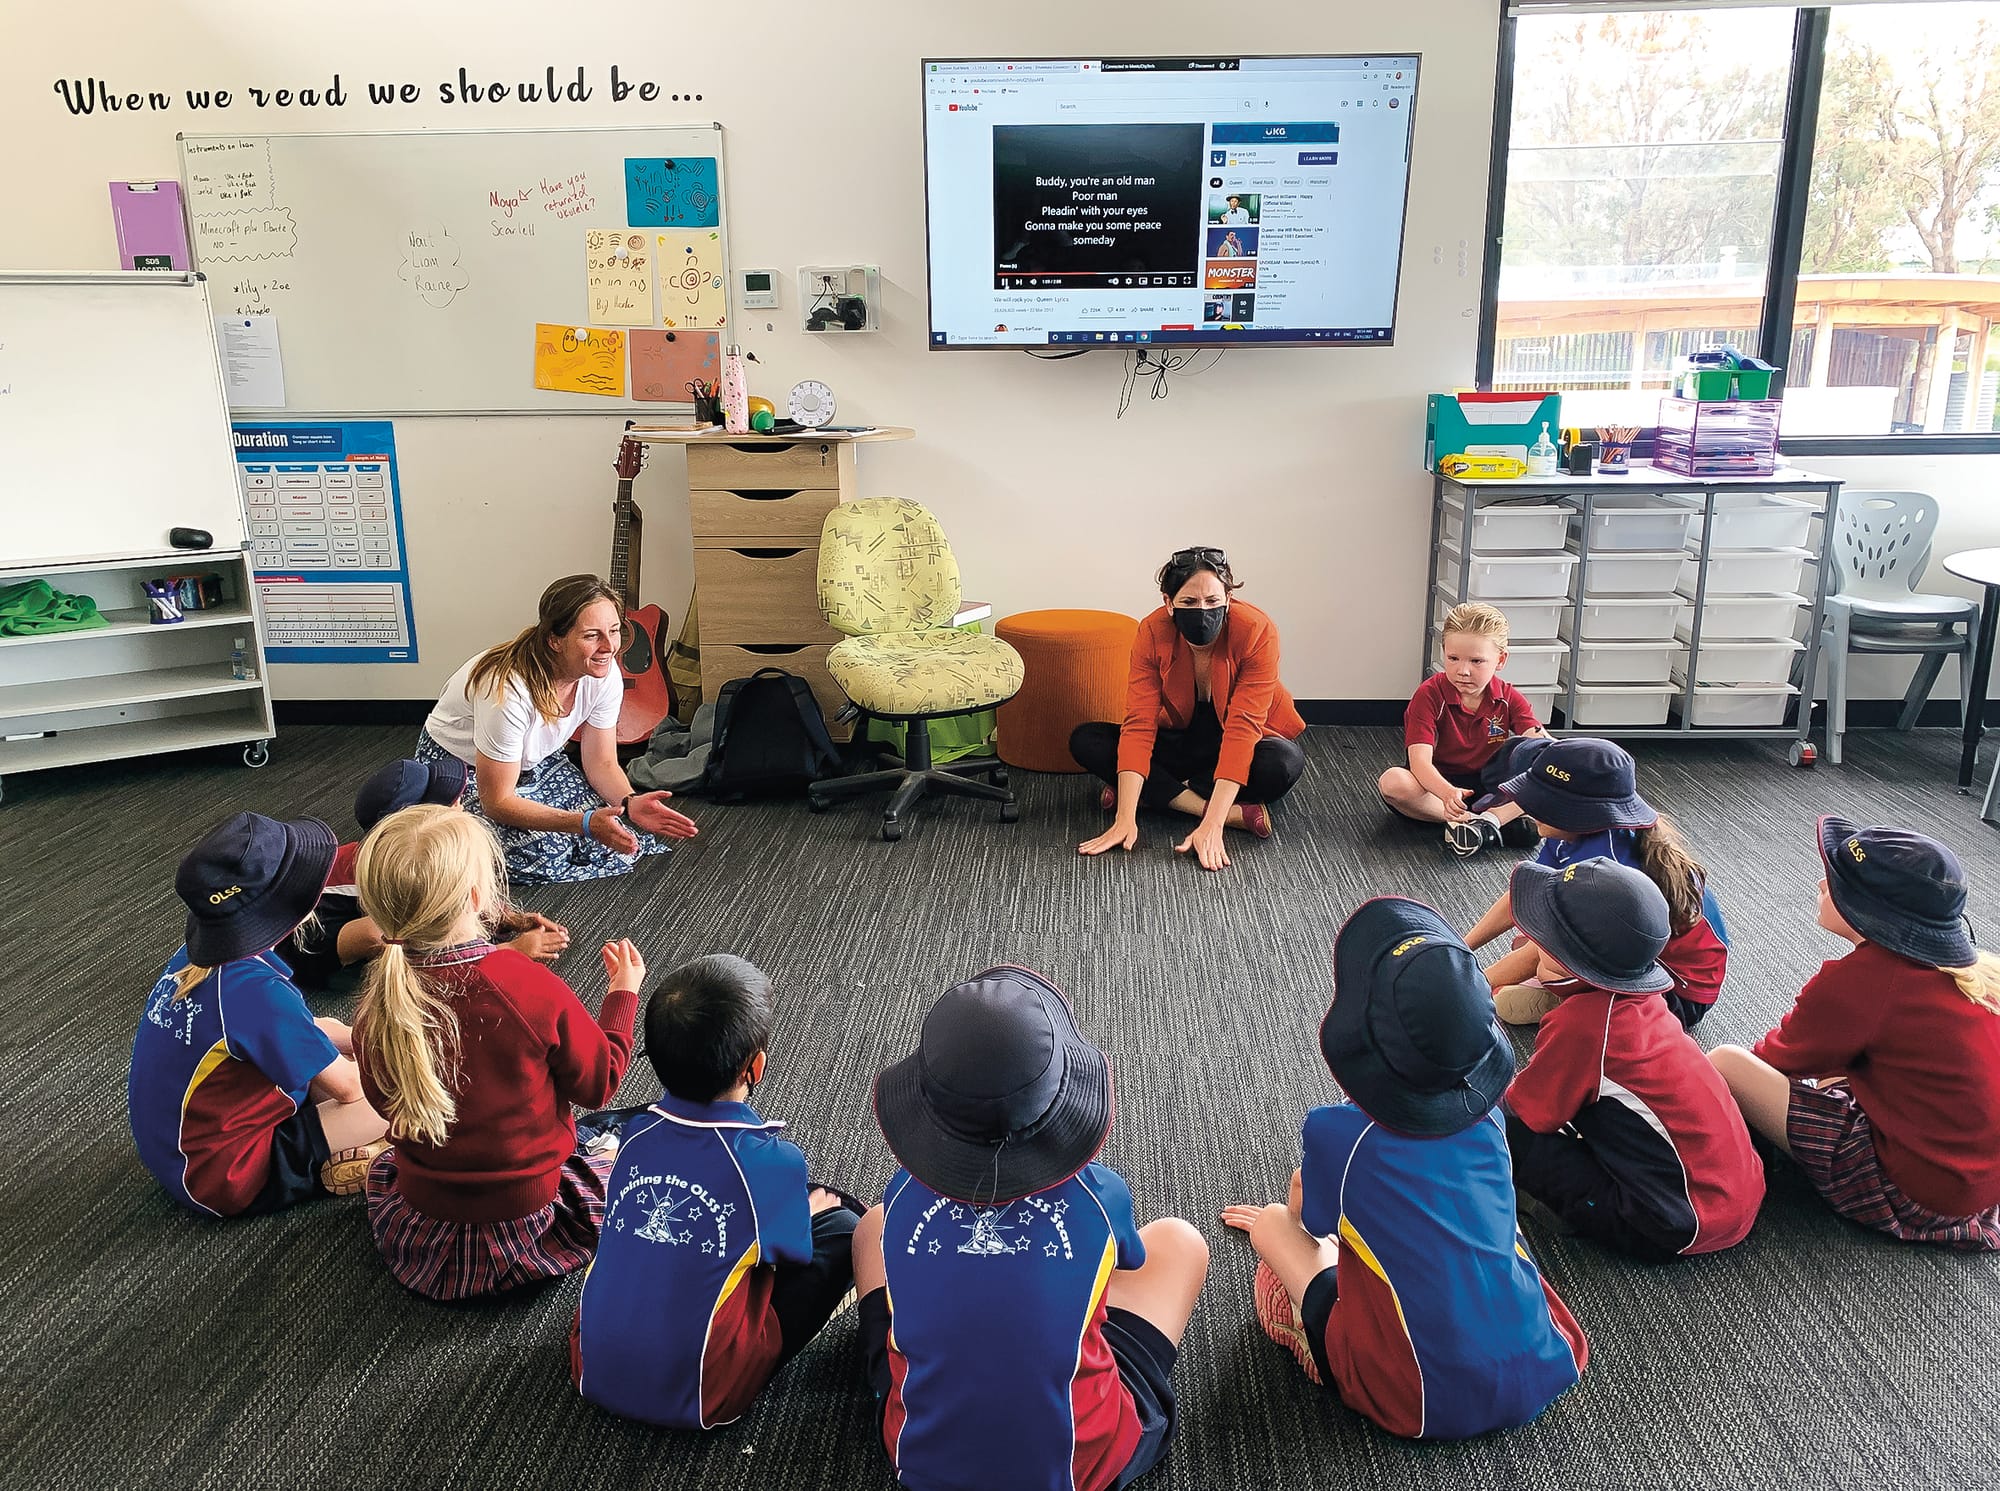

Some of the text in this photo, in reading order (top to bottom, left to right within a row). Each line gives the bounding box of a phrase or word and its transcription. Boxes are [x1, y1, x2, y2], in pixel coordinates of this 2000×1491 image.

[53, 77, 170, 116] When
[186, 90, 232, 110] we
[248, 74, 347, 108] read
[368, 84, 420, 104] we
[439, 66, 592, 104] should
[959, 104, 978, 112] YouTube
[1265, 127, 1286, 136] UKG
[185, 141, 226, 154] Instruments
[539, 171, 587, 197] Have you
[1035, 175, 1155, 188] Buddy, you're an old man
[543, 183, 589, 213] returned
[1072, 191, 1118, 201] Poor man
[1041, 205, 1148, 218] Pleadin' with your eyes
[200, 219, 240, 237] Minecraft
[1024, 221, 1162, 232] Gonna make you some peace
[1073, 235, 1116, 247] someday
[1207, 267, 1256, 279] MONSTER
[414, 274, 453, 292] Raine
[234, 431, 289, 448] Duration
[1545, 764, 1572, 782] OLSS
[1847, 839, 1866, 863] OLSS
[209, 884, 242, 905] OLSS
[1392, 937, 1427, 956] OLSS
[665, 1174, 688, 1189] the
[690, 1183, 721, 1214] OLSS
[906, 1195, 1074, 1260] I'm join LSS Stars
